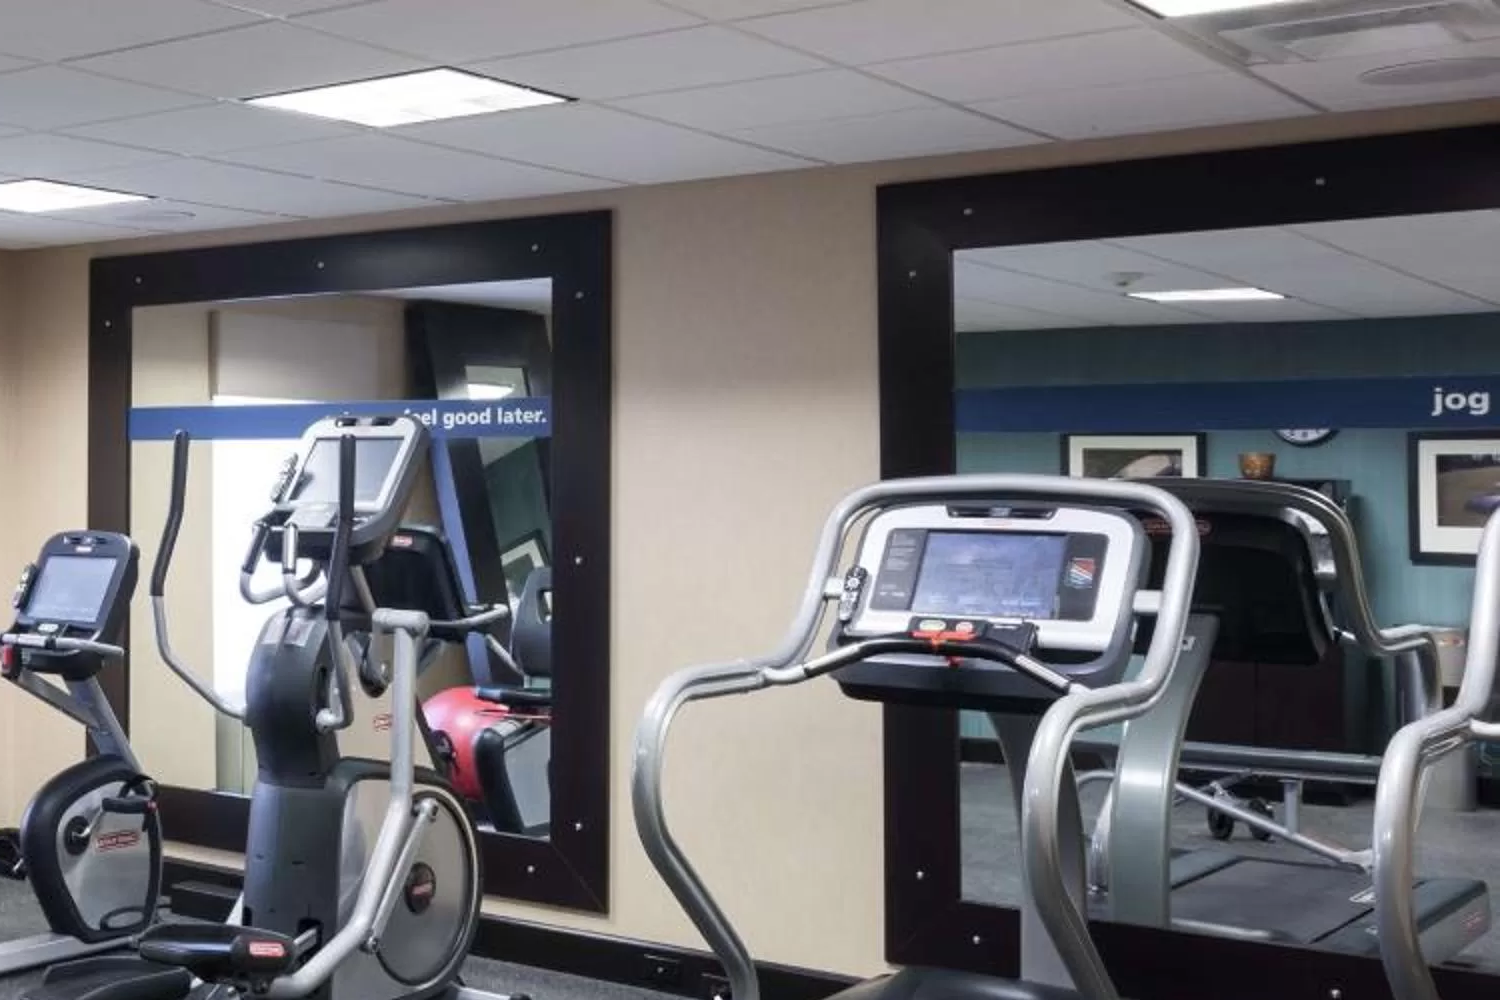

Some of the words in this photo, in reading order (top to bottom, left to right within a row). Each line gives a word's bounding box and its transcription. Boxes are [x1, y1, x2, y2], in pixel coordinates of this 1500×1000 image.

[1431, 387, 1489, 416] jog
[404, 408, 437, 425] el
[443, 407, 491, 429] good
[497, 407, 547, 423] later.
